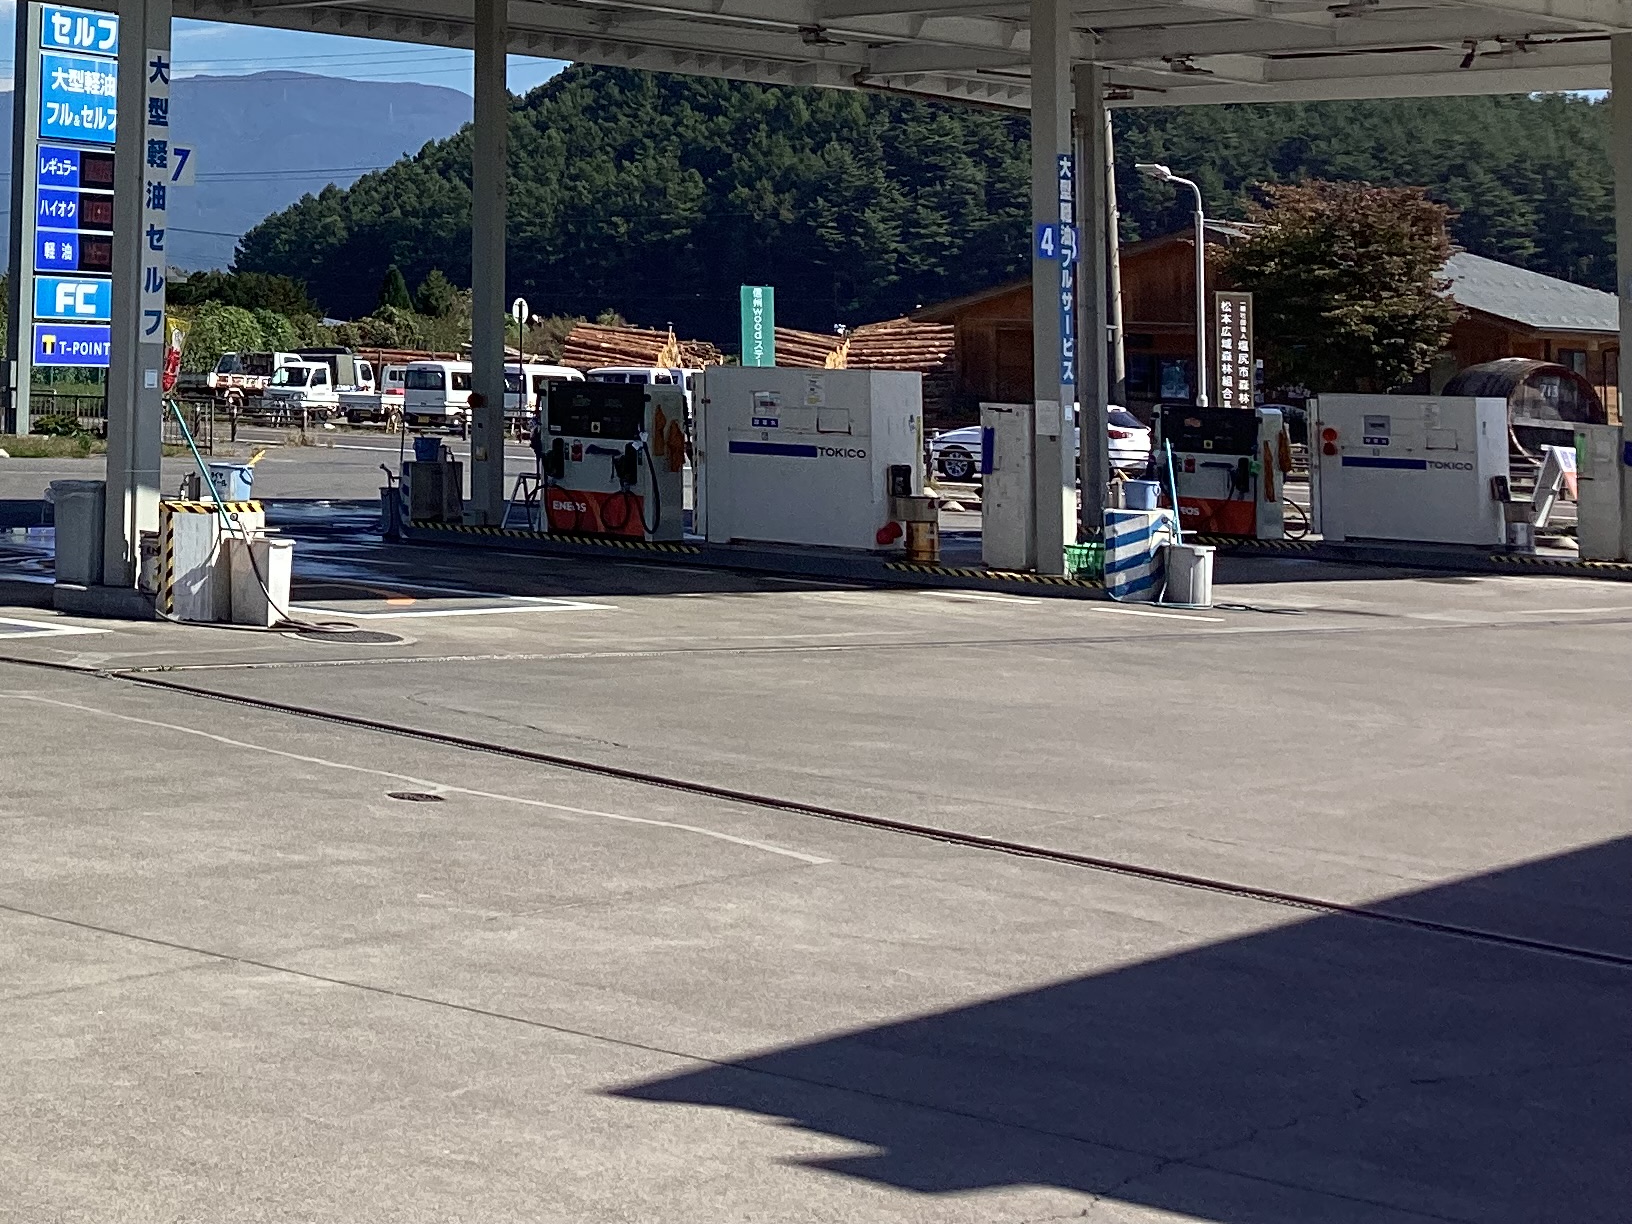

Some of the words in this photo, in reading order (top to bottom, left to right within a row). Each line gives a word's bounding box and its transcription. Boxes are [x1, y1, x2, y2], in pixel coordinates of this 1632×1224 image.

[52, 11, 117, 50] セルフ
[51, 66, 116, 98] 大型軽油
[40, 157, 78, 176] レギュラー
[171, 148, 191, 181] 7
[40, 199, 76, 217] ハイオク
[144, 55, 169, 336] 大型軽油セルフ
[1040, 227, 1055, 256] 4
[1059, 156, 1075, 381] 大型軽油フルサービス
[55, 283, 99, 314] FC
[58, 341, 111, 356] T-POINT
[819, 446, 867, 459] TOKICO
[1428, 461, 1474, 471] TOKICO
